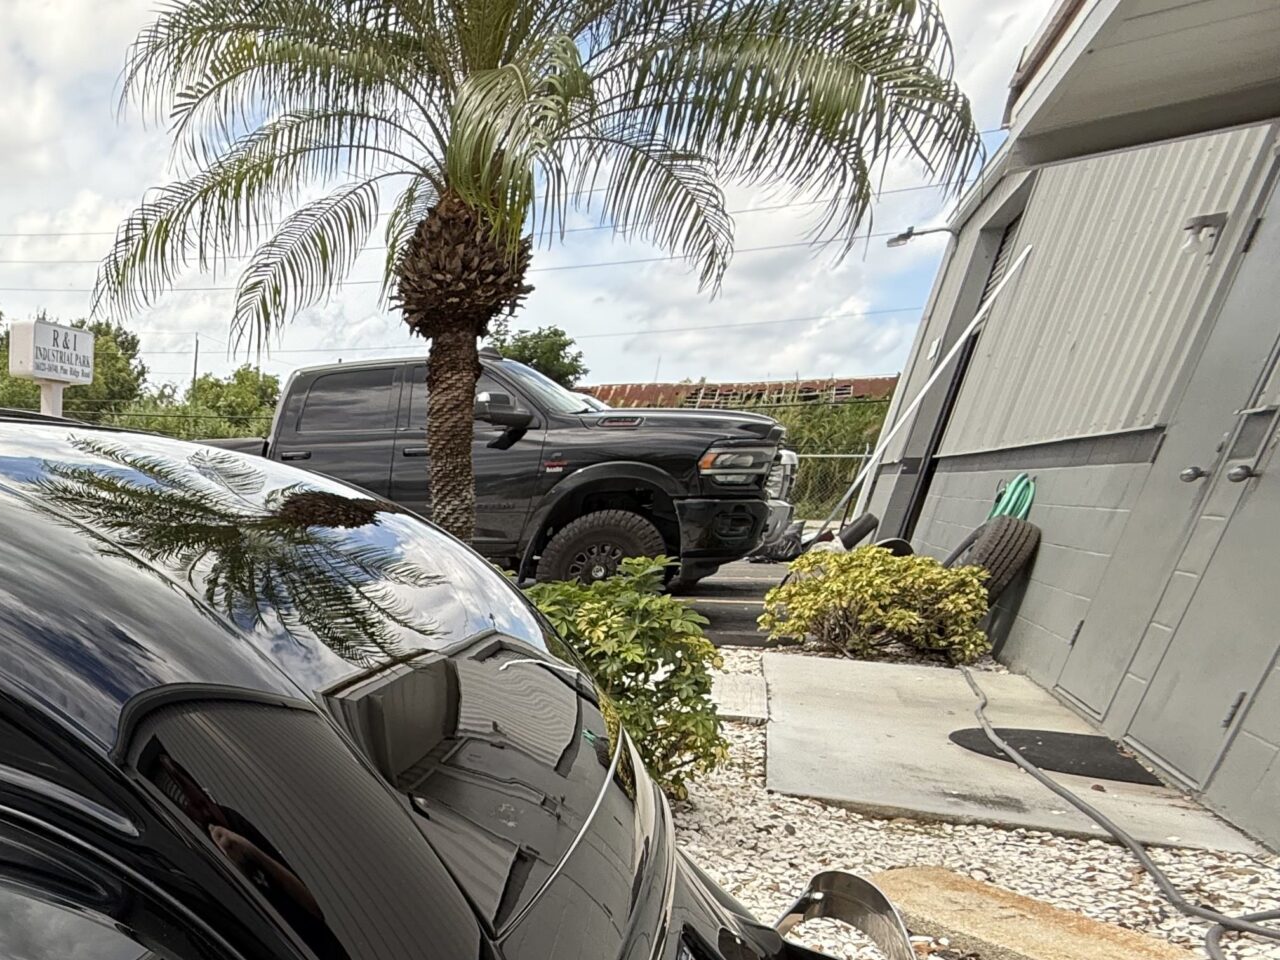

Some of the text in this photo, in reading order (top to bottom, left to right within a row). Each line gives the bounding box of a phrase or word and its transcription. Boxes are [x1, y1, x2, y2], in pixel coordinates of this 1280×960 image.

[53, 330, 59, 348] R
[63, 332, 70, 350] &
[35, 346, 74, 366] INDUSTRIAL
[75, 353, 91, 368] PARK
